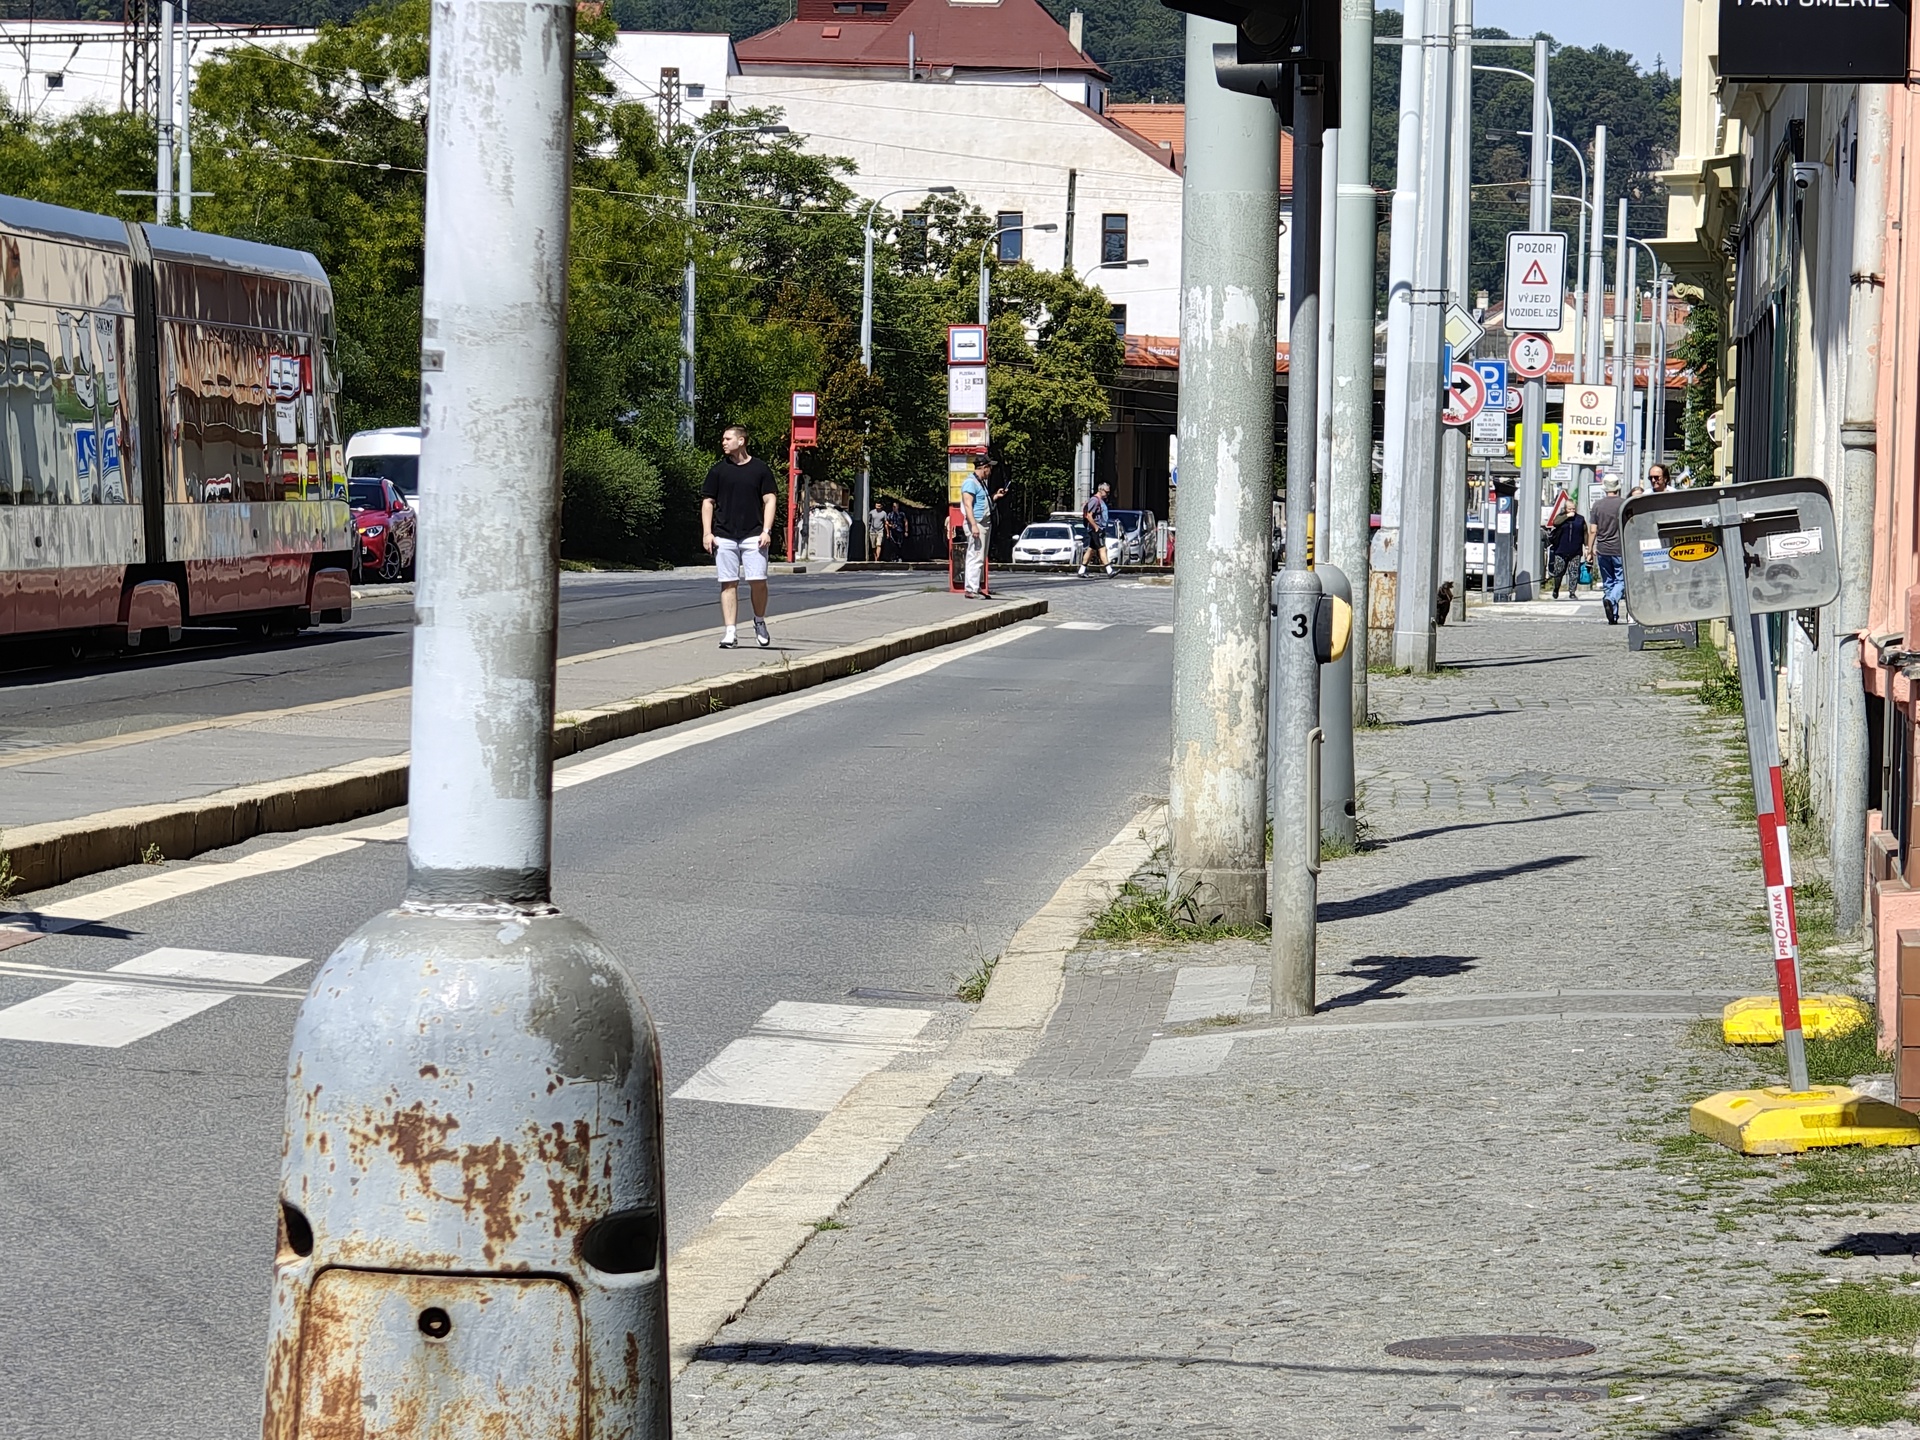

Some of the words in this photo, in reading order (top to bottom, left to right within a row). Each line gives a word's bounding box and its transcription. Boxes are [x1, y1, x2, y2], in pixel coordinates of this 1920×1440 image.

[1517, 243, 1557, 254] POZOR!
[1518, 293, 1551, 303] VÝJEZD
[1509, 308, 1544, 317] VOZIDEL
[1545, 308, 1559, 317] IZS
[1480, 366, 1499, 383] P
[1570, 415, 1607, 426] TROLEJ
[1291, 613, 1308, 639] 3
[1772, 893, 1788, 956] PROZNAK
